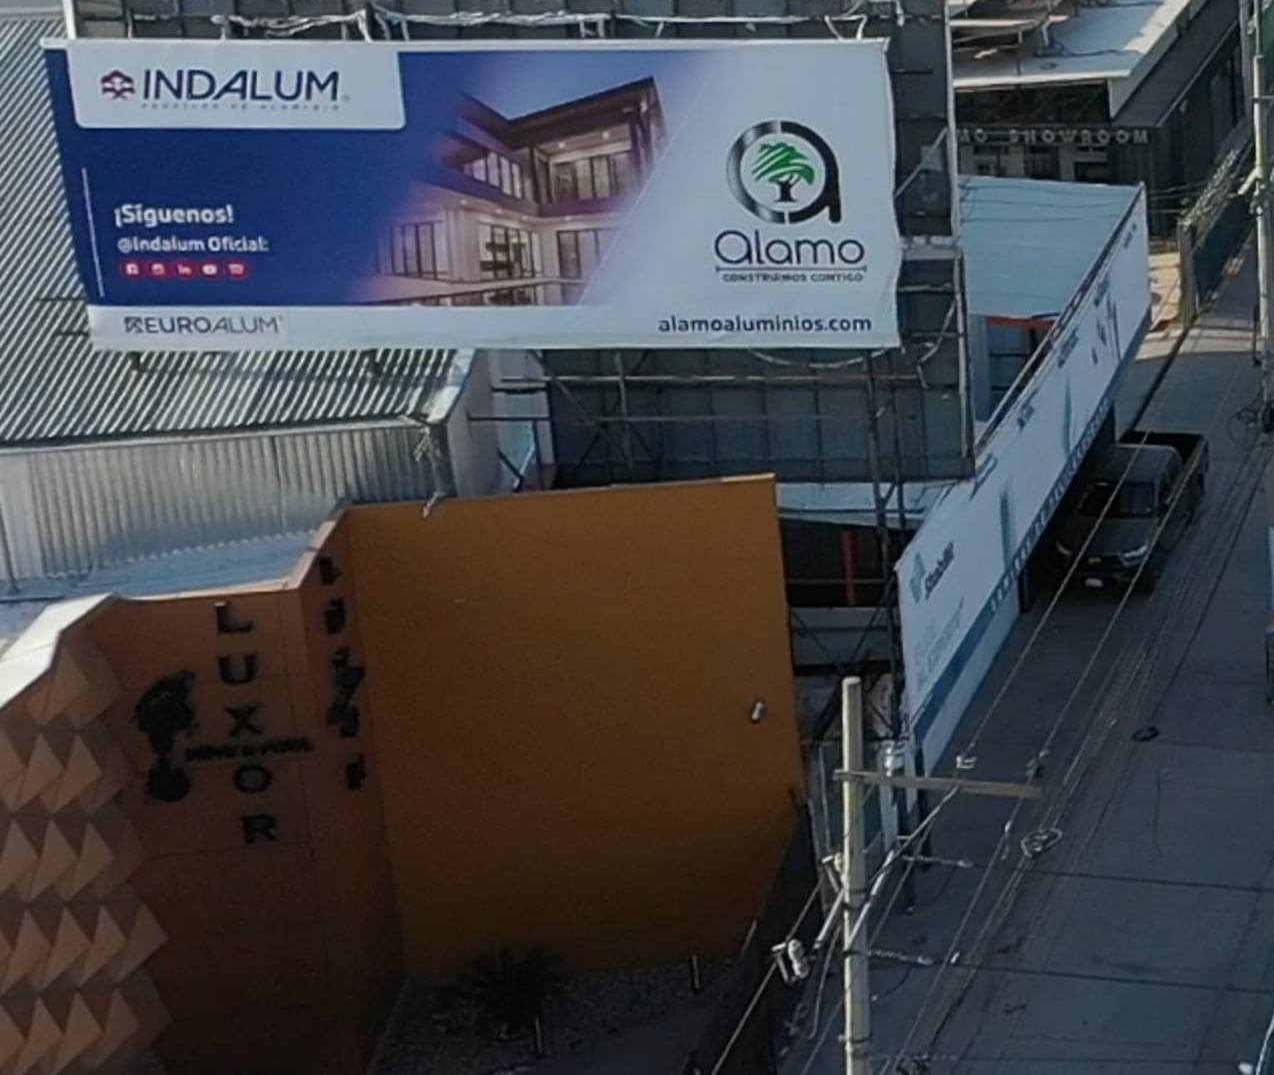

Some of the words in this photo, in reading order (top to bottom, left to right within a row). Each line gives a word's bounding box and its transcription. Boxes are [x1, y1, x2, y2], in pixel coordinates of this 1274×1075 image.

[143, 69, 339, 101] INDALUM
[114, 203, 234, 227] ¡Síguenos!
[117, 235, 205, 254] @Indalum
[714, 229, 866, 265] alamo
[810, 273, 864, 283] CONTIGO
[144, 316, 279, 334] EUROALUM
[658, 314, 872, 332] alamoaluminios.com
[213, 602, 279, 845] LUXOR
